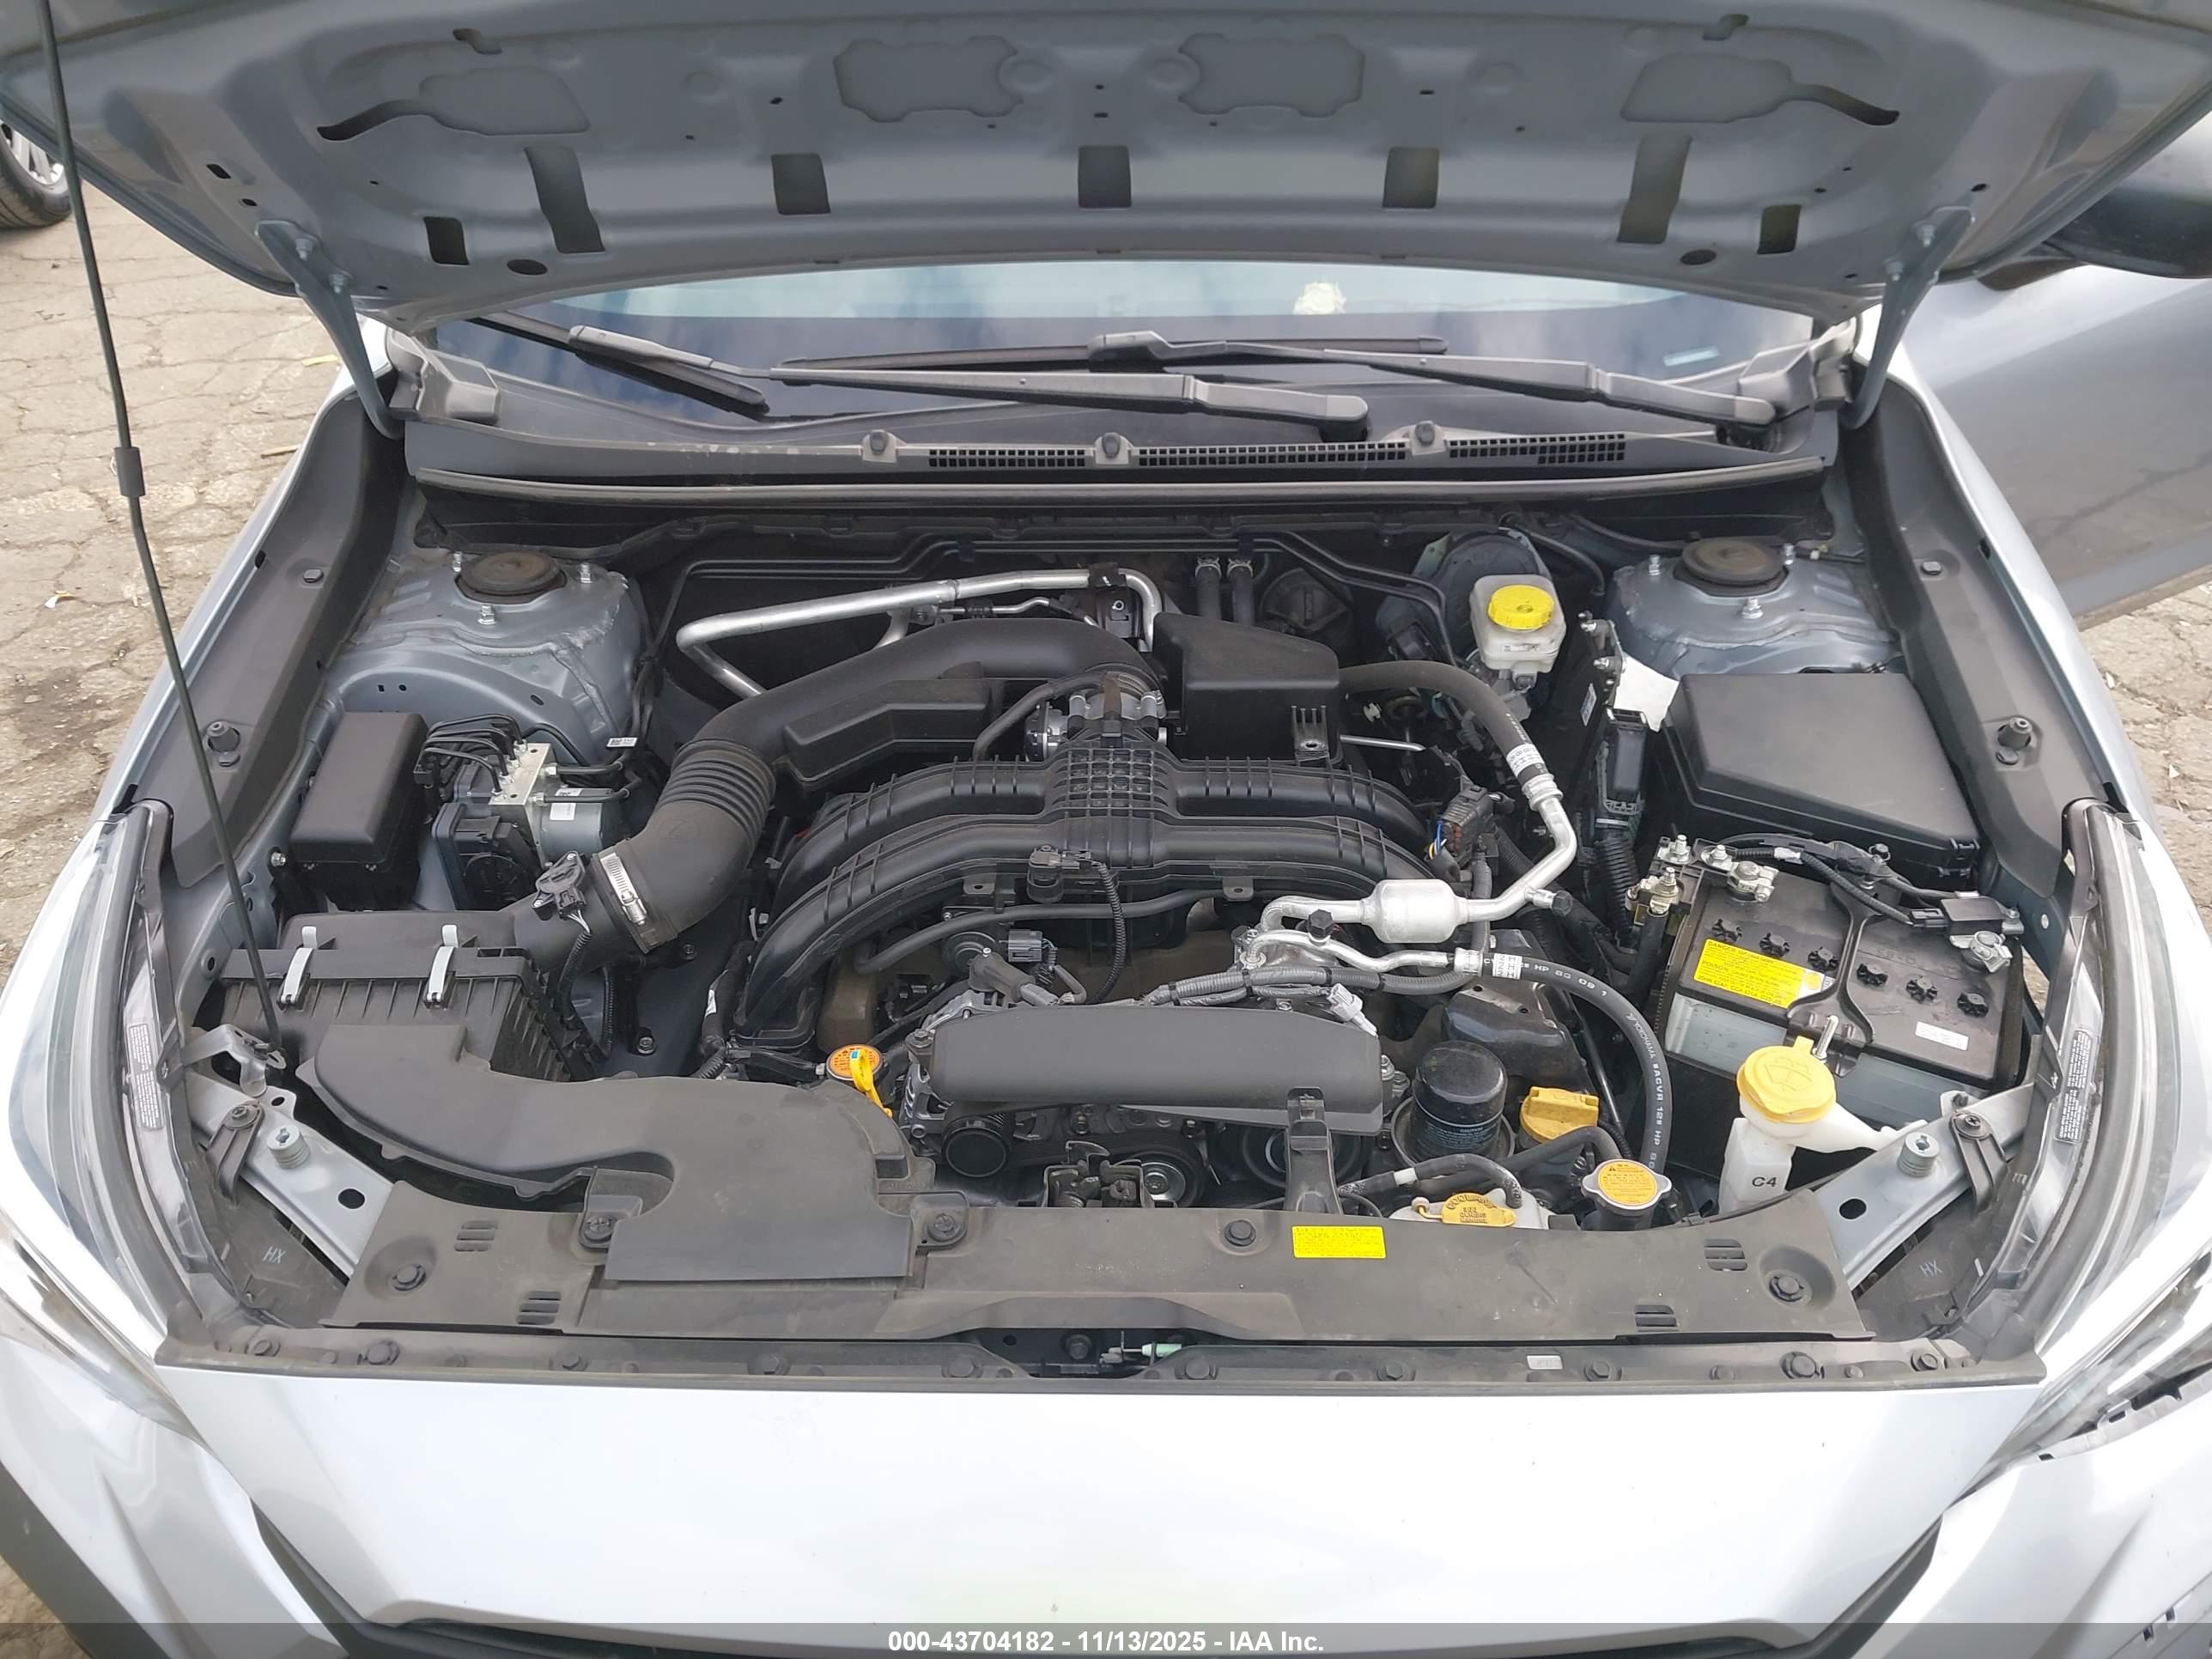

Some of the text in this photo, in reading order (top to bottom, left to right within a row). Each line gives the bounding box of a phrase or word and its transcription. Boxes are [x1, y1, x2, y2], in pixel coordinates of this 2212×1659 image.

[1534, 963, 1549, 972] HP
[1654, 1130, 1662, 1146] HP
[1752, 1176, 1777, 1187] C4
[1919, 1260, 1943, 1277] HX
